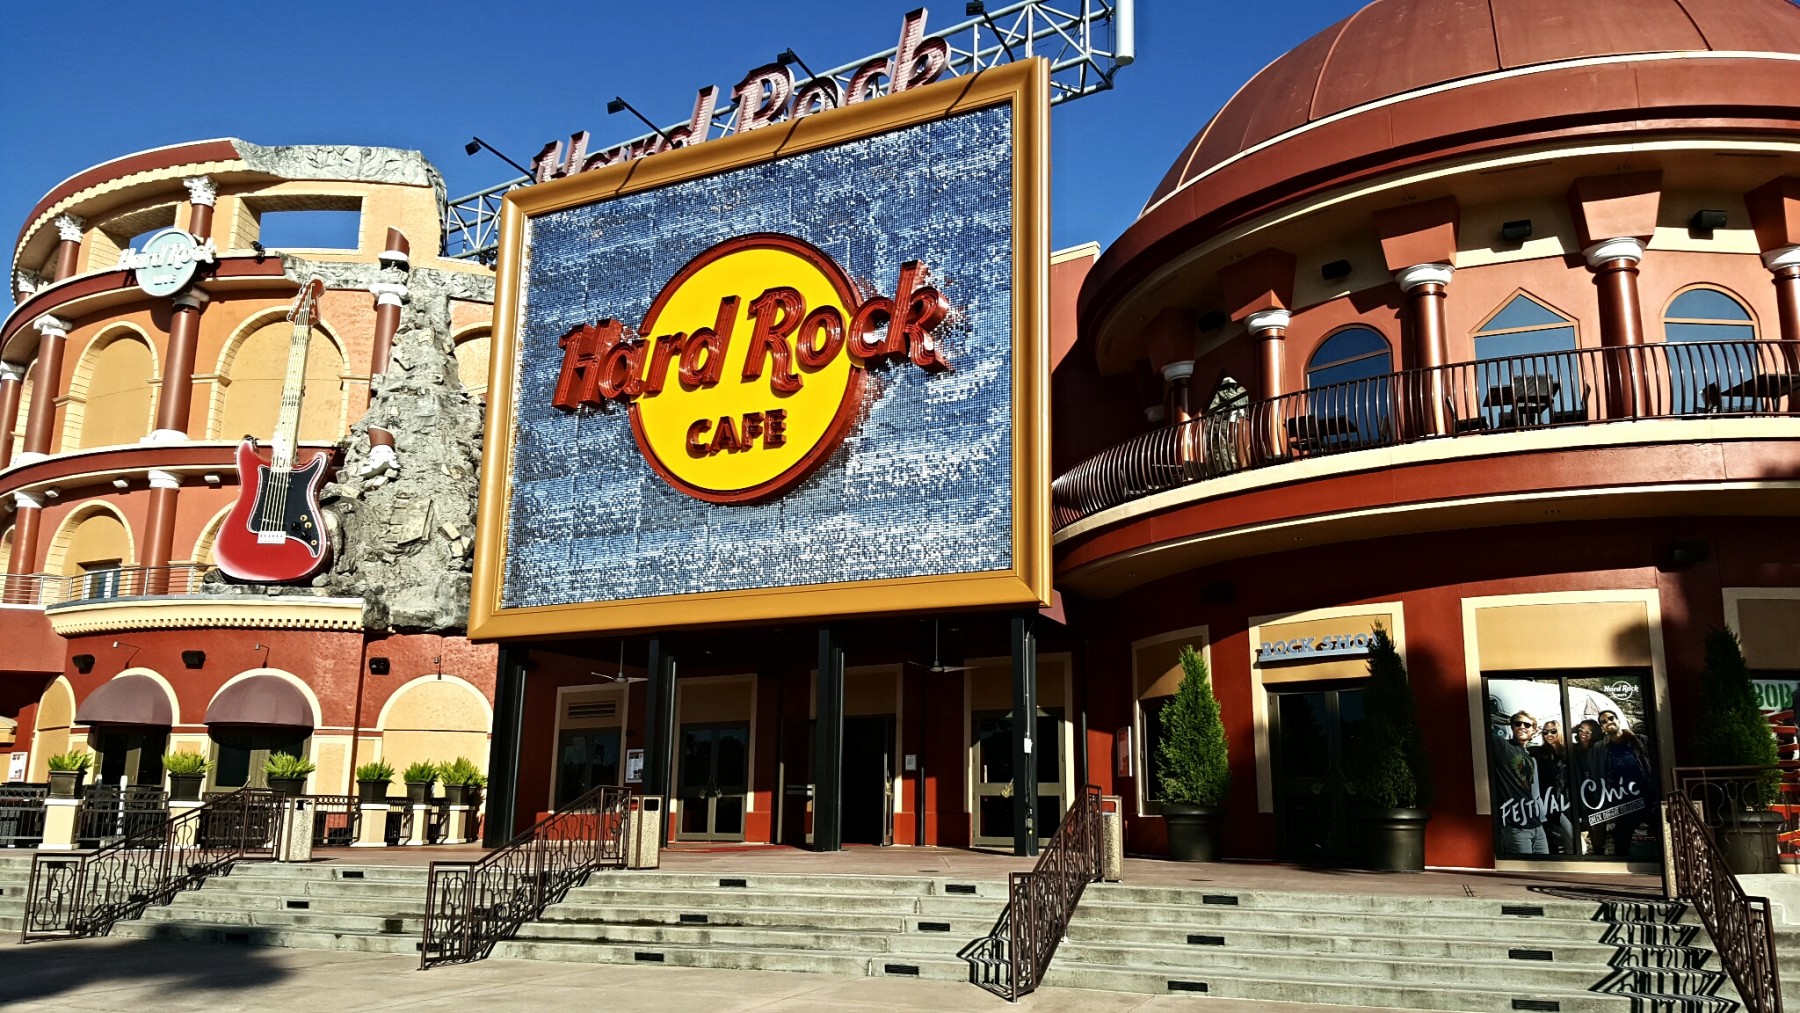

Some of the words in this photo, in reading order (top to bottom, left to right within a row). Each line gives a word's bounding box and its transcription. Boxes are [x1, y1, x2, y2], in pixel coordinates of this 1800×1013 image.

[118, 243, 169, 271] Hard
[166, 238, 217, 270] Rock
[552, 294, 741, 411] Hard
[743, 259, 952, 394] Rock
[686, 409, 787, 457] CAFE
[1259, 637, 1317, 657] ROCK
[1321, 632, 1380, 652] SHO
[1622, 685, 1639, 693] Rock
[1500, 786, 1571, 827] FESTIVAL
[1581, 777, 1640, 810] Chic
